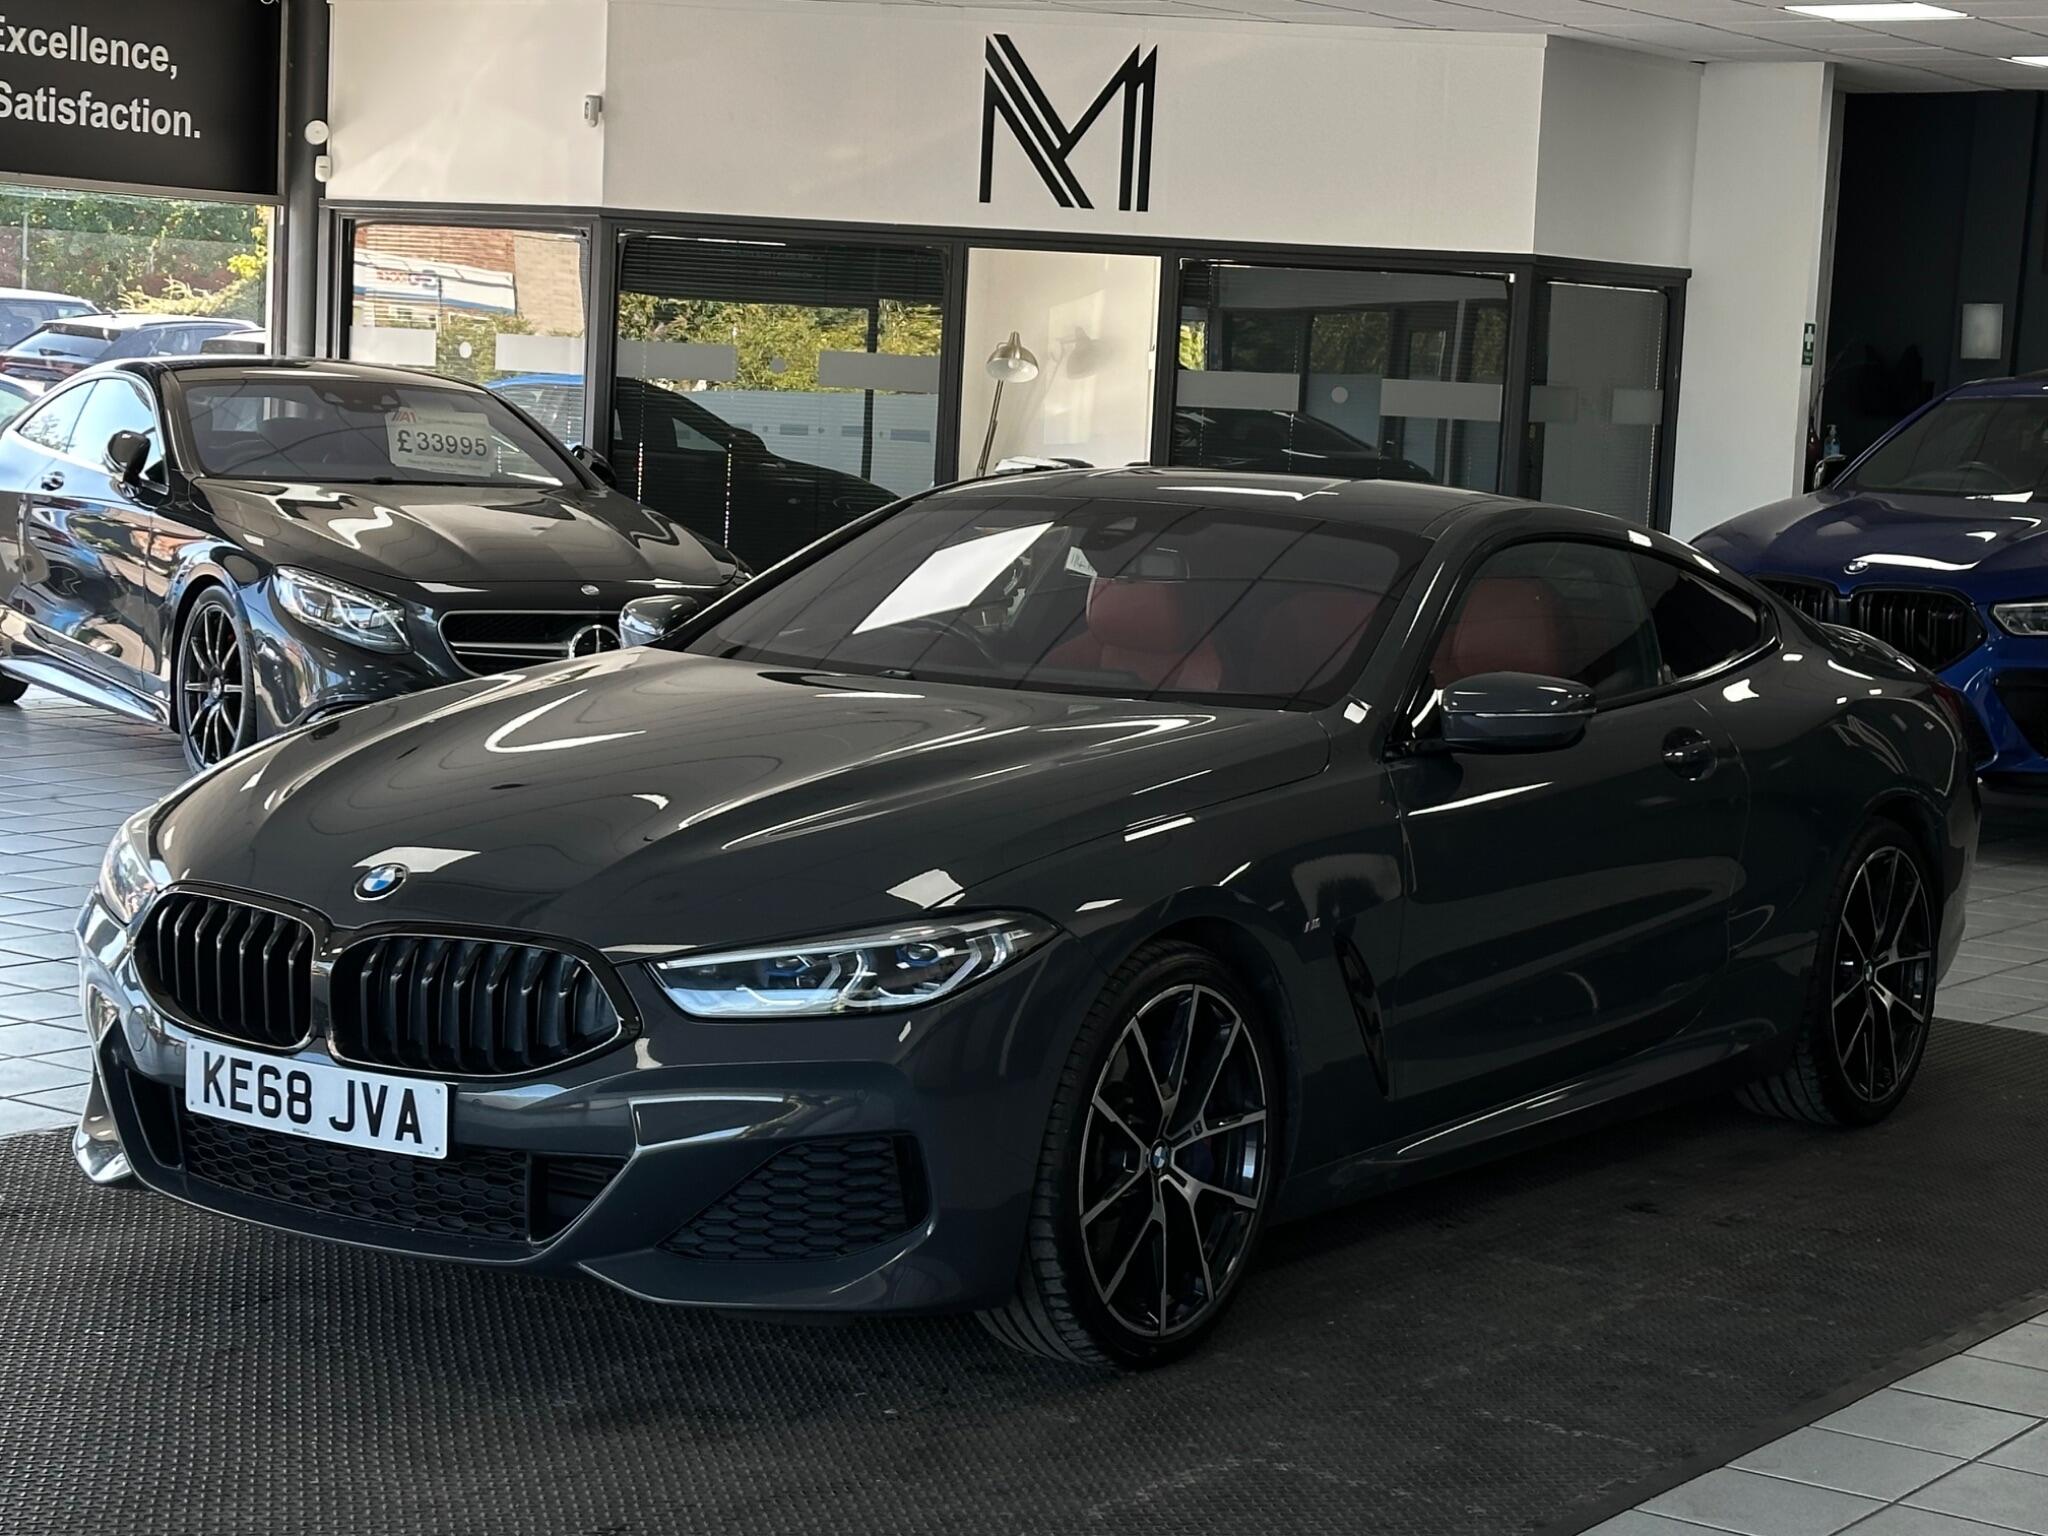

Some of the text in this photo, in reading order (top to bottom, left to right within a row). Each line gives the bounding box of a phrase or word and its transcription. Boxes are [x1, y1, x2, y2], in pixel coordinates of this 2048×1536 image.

[0, 16, 178, 80] xcellence,
[203, 1051, 422, 1144] KE68 JVA
